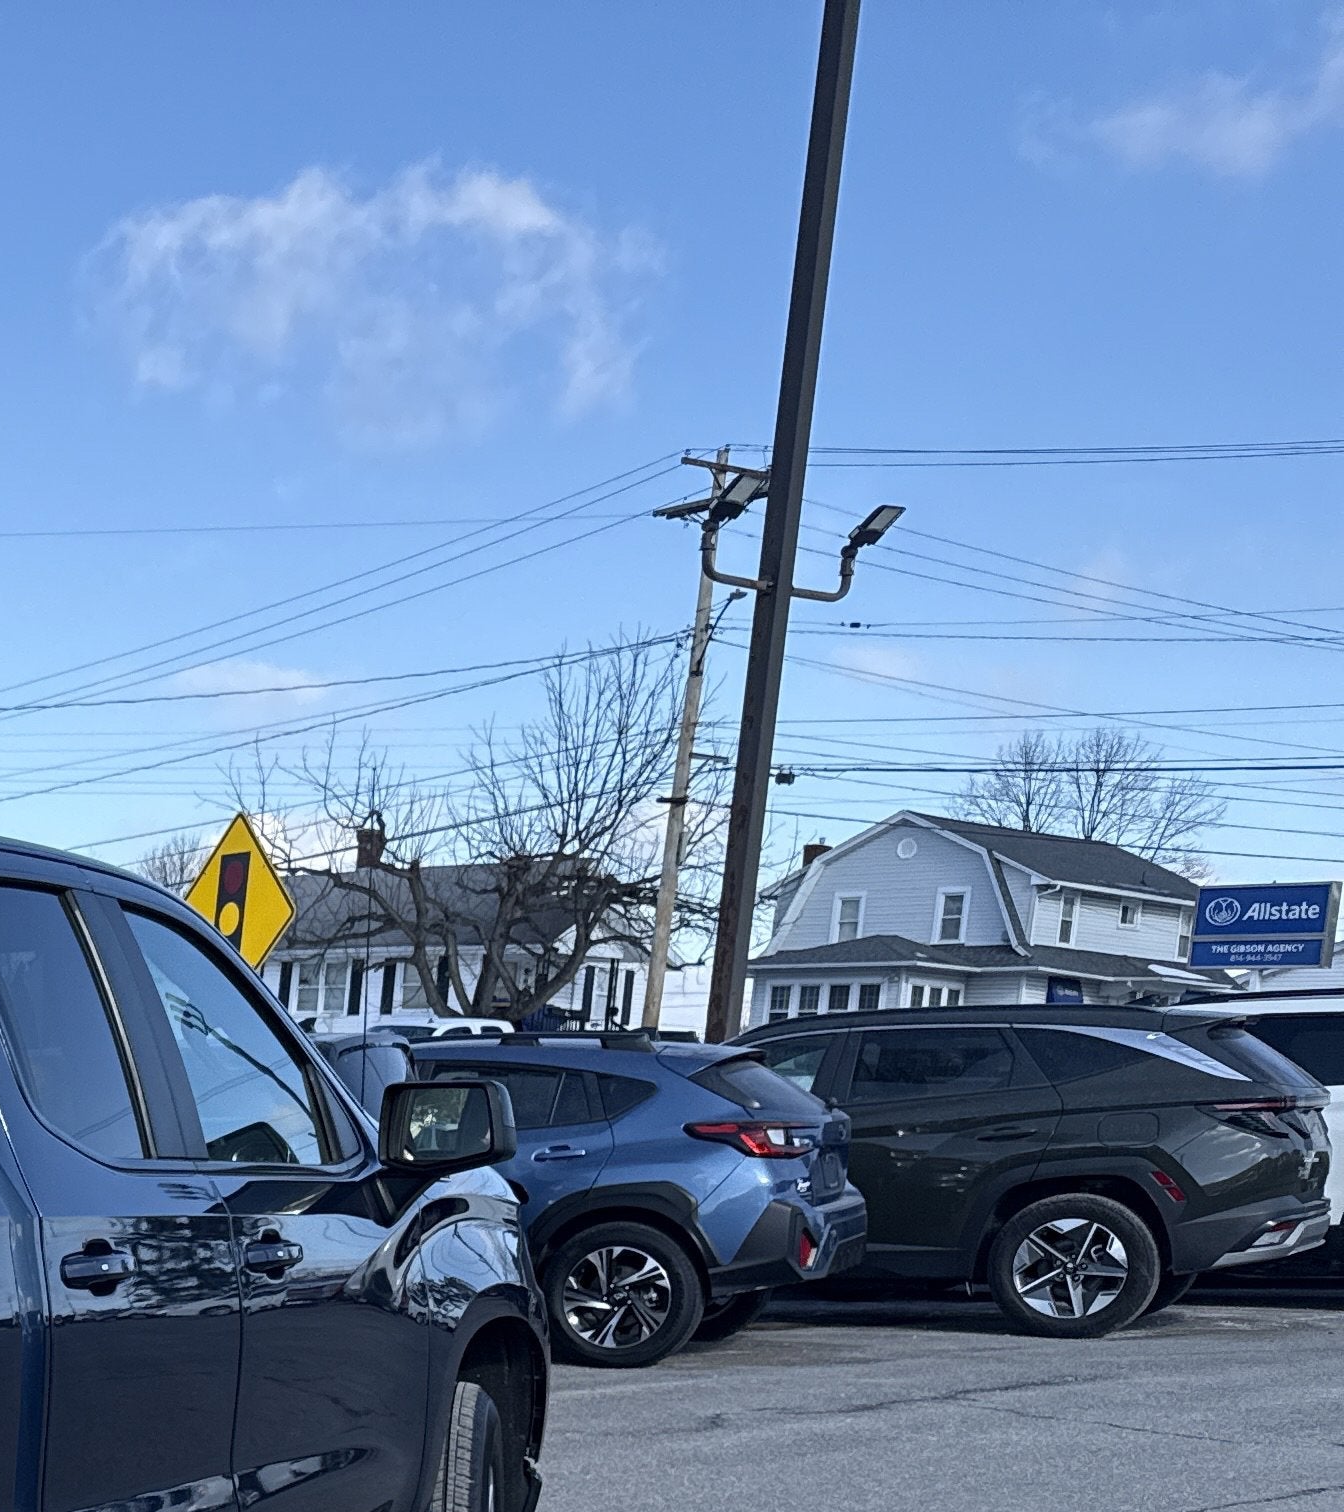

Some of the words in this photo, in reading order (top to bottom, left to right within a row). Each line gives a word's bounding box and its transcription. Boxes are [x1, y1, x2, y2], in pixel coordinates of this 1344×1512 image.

[1242, 901, 1320, 921] Allstate
[1211, 945, 1229, 954] THE
[1230, 944, 1265, 953] GIBSON
[1266, 943, 1305, 952] AGENCY
